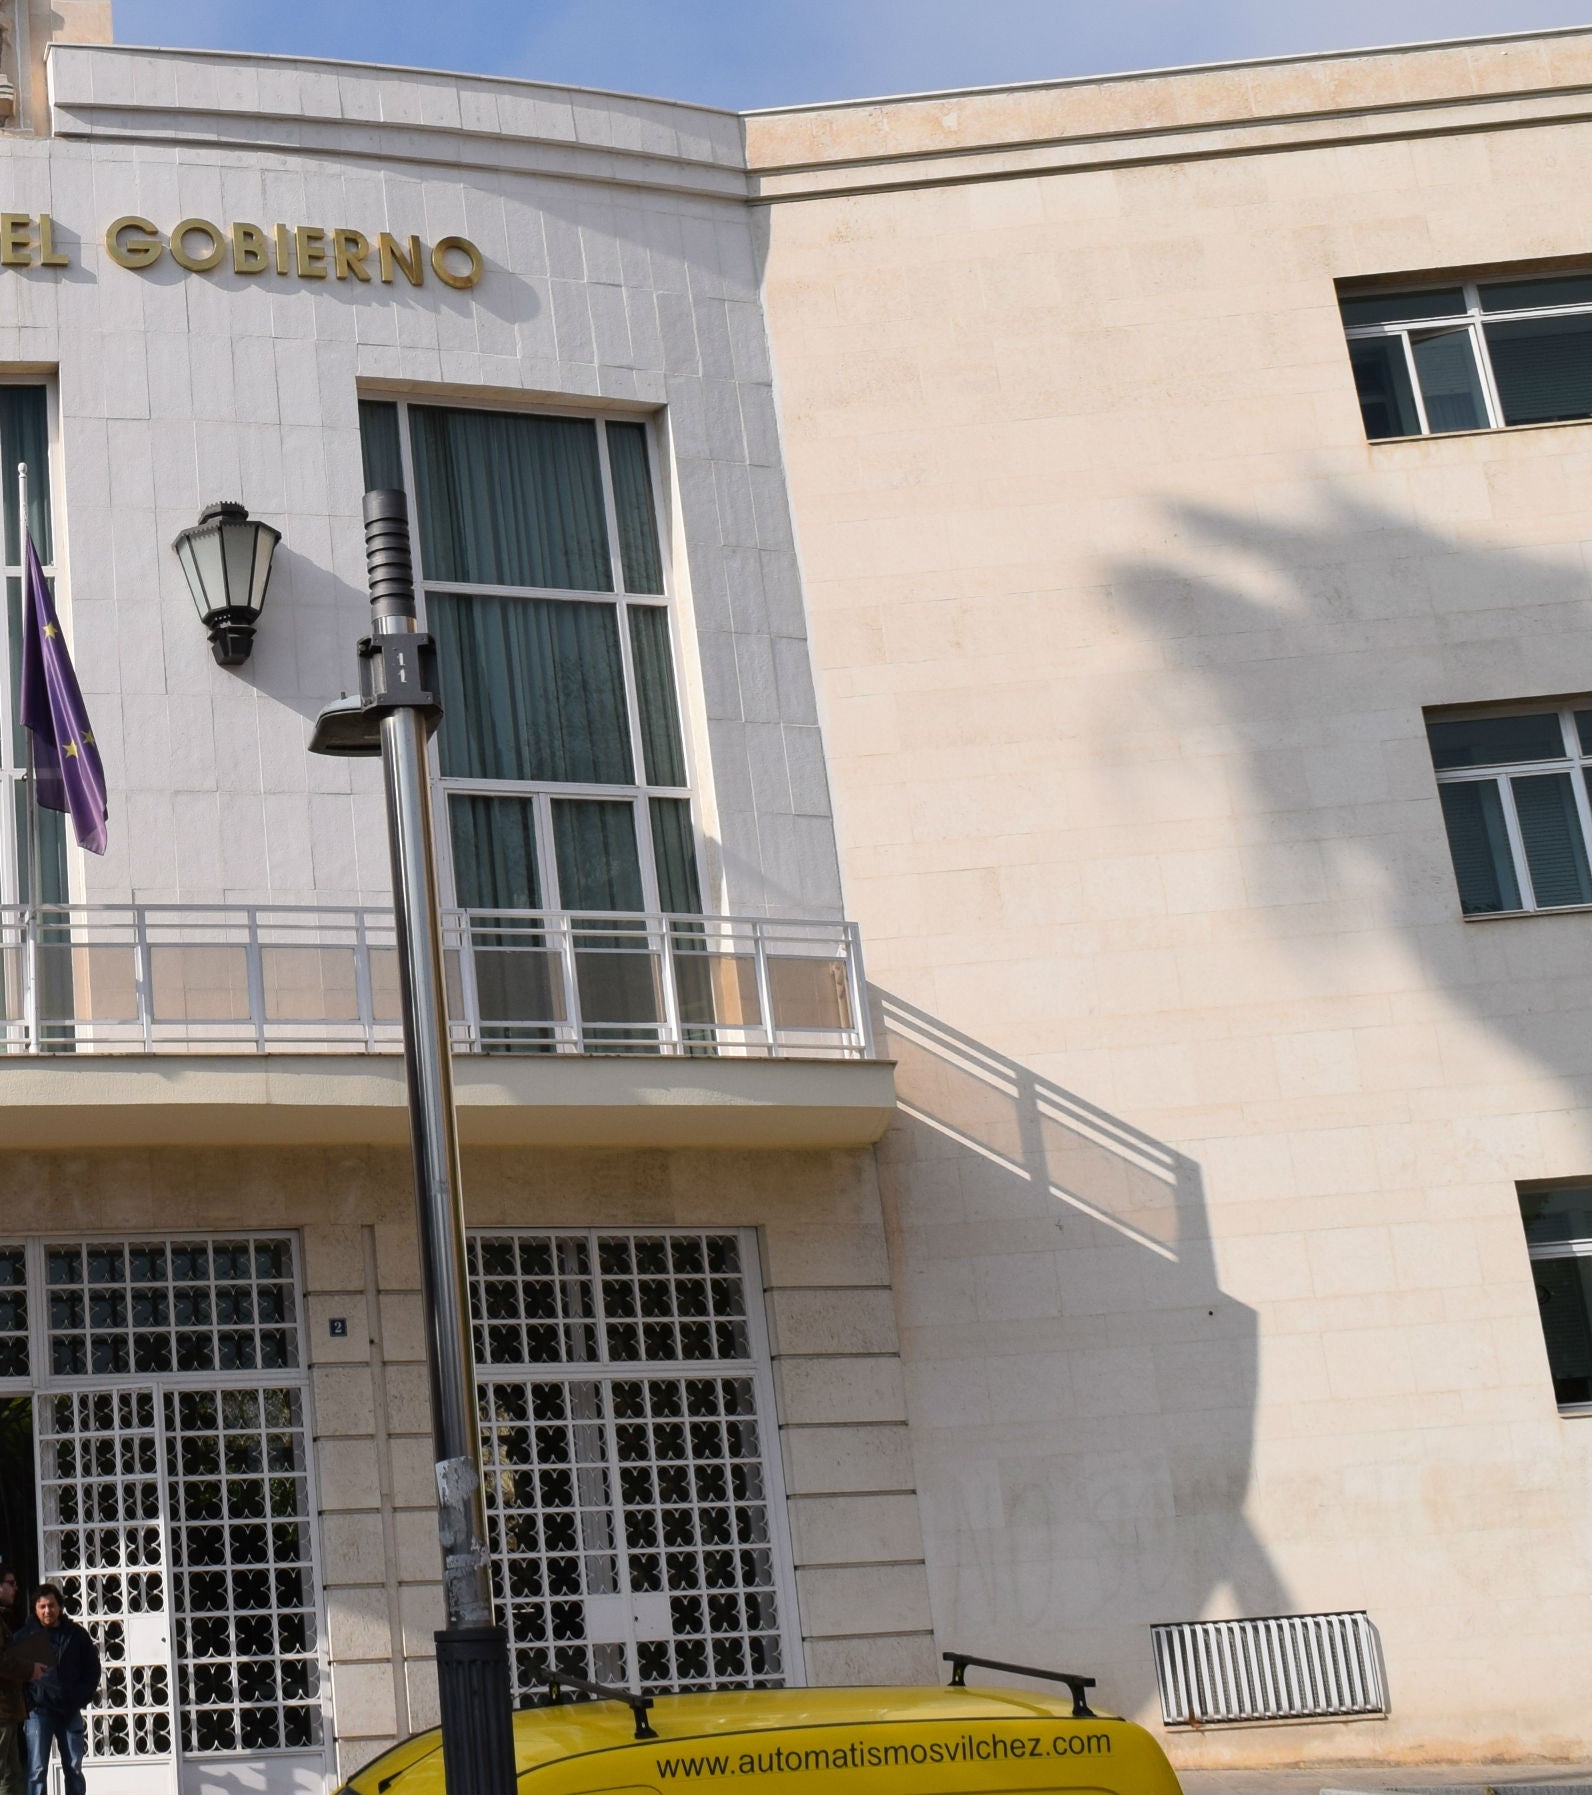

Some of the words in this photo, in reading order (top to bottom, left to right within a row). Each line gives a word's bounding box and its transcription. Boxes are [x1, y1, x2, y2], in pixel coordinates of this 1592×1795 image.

[105, 215, 484, 290] GOBIERNO
[333, 1321, 343, 1333] 2
[656, 1733, 1111, 1779] www.automatismosvilchez.com
